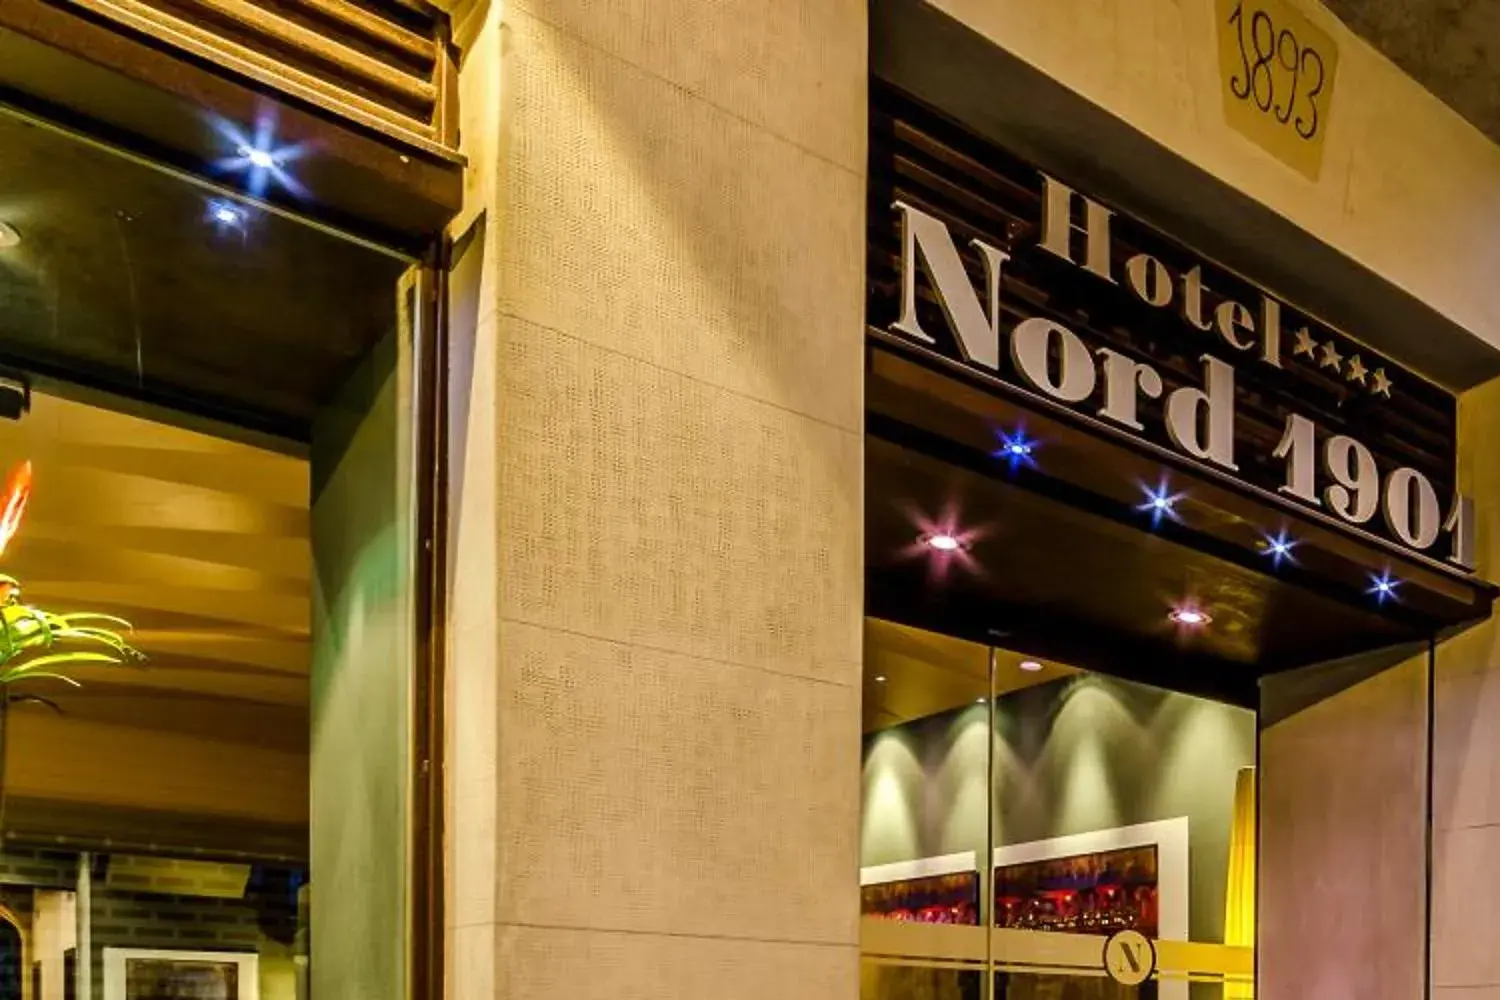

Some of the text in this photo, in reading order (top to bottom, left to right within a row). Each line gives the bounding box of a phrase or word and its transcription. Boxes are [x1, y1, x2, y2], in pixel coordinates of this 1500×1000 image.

[1228, 4, 1325, 140] 1893
[1036, 172, 1283, 369] Hotel
[891, 200, 1475, 569] Nord 1901
[1118, 941, 1142, 974] N
